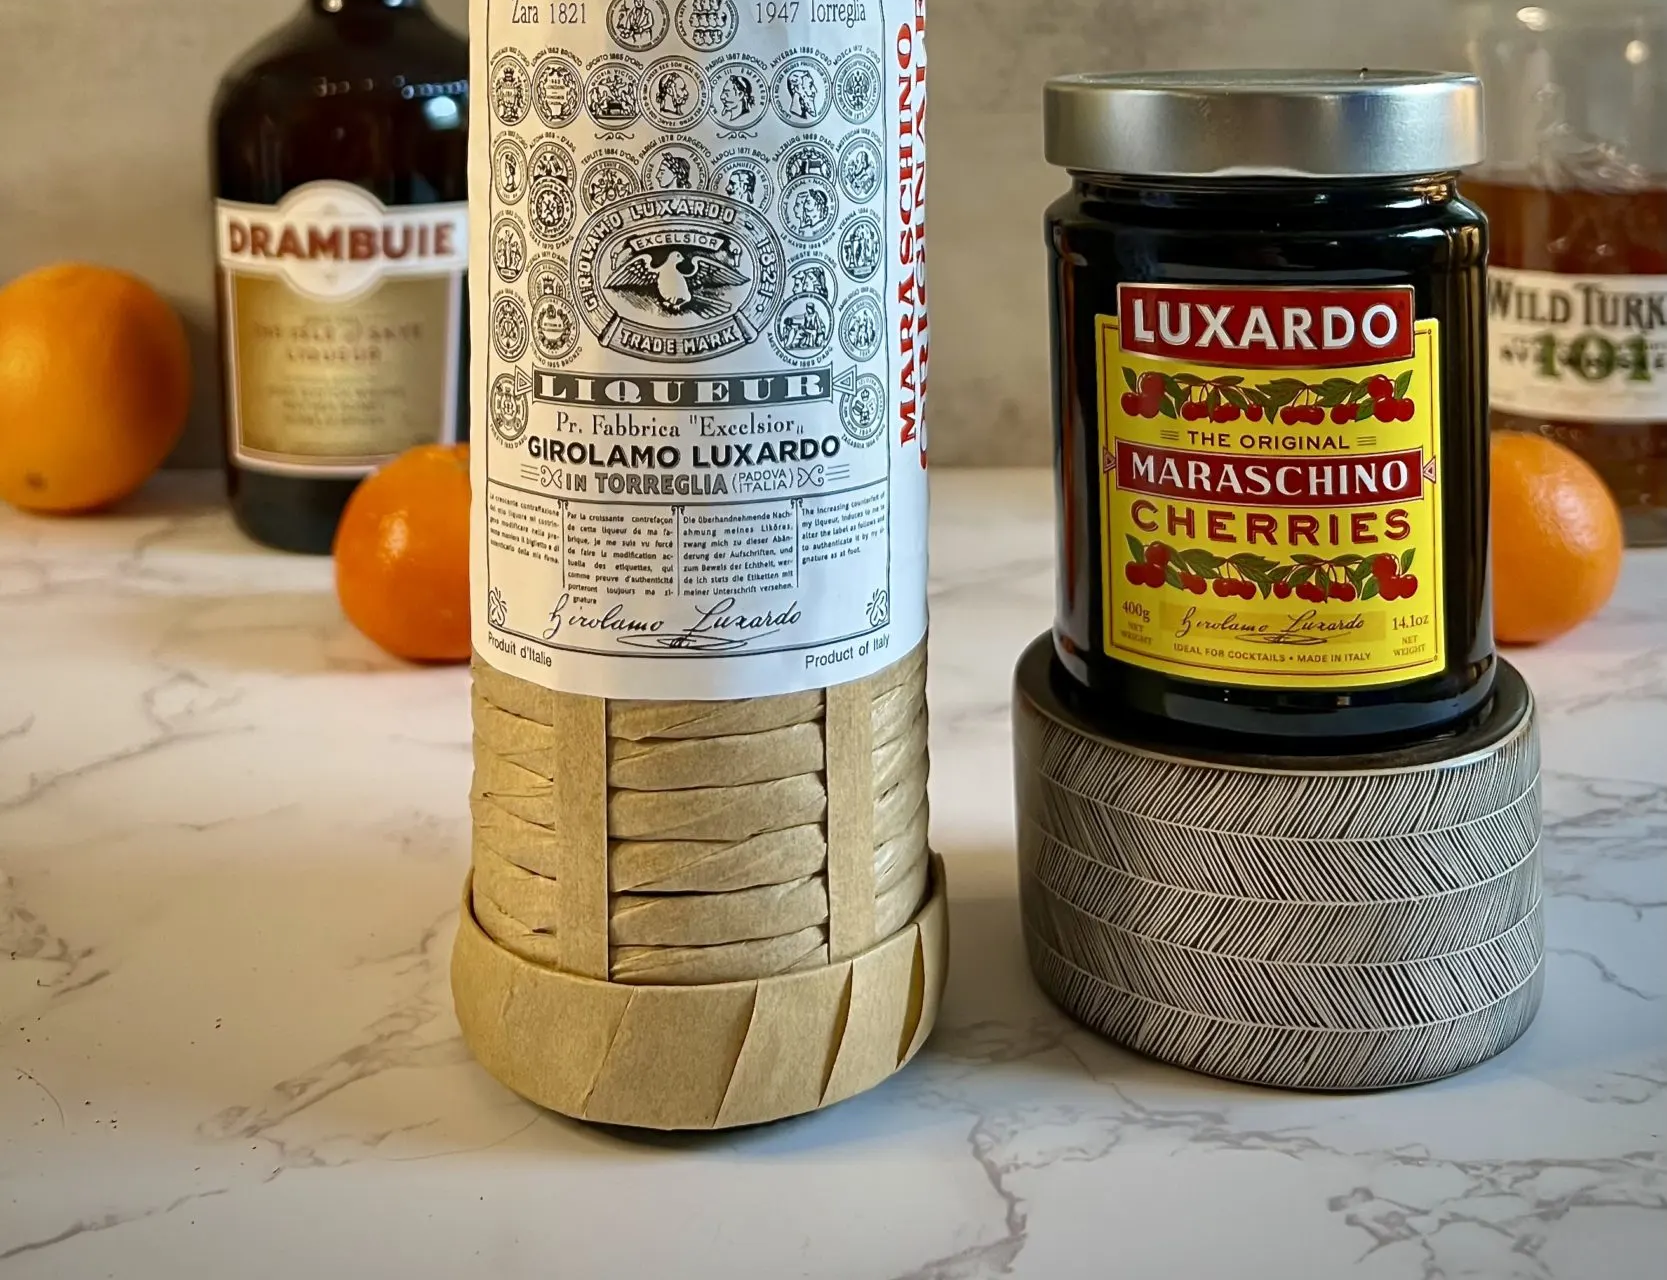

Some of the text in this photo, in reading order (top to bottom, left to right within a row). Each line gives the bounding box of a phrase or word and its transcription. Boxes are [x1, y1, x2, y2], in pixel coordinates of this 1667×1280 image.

[550, 3, 586, 24] 1821
[756, 2, 799, 23] 1947
[229, 222, 456, 260] DRAMBUIE
[636, 234, 718, 249] EXCELSIOR
[897, 23, 917, 449] MARASCHINO
[577, 199, 776, 312] GIROLAMO LUXARDO 1821
[1133, 297, 1398, 351] LUXARDO
[621, 326, 739, 356] TRADE MARK
[1533, 331, 1651, 381] 101
[539, 373, 824, 405] LIQUEUR
[556, 411, 582, 434] Pr.
[593, 414, 680, 437] Fabbrica
[528, 435, 841, 469] GIROLAMO LUXARDO
[1187, 431, 1350, 451] THE ORIGINAL
[566, 474, 587, 491] IN
[595, 471, 728, 496] TORREGLIA
[1131, 451, 1408, 496] MARASCHINO
[632, 516, 673, 525] contrefaçon
[802, 508, 814, 516] The
[1131, 500, 1411, 546] CHERRIES
[683, 529, 716, 537] ahmung
[684, 541, 706, 549] zwang
[746, 537, 768, 545] dieser
[683, 553, 709, 561] derung
[780, 546, 793, 554] und
[684, 588, 709, 596] meiner
[713, 586, 756, 595] Unterschrift
[683, 597, 802, 633] Luxardo
[1122, 601, 1150, 623] 400g
[1282, 610, 1364, 632] Luxardo
[1392, 614, 1429, 631] 14.1oz
[488, 632, 552, 667] Produit d'Italie
[1393, 644, 1426, 656] WEIGHT
[1402, 635, 1418, 645] NET
[806, 634, 890, 669] Product of Italy
[1174, 643, 1201, 655] IDEAL
[1205, 648, 1225, 657] FOR
[1227, 650, 1285, 662] COCKTAILS
[1331, 654, 1340, 662] IN
[1344, 652, 1370, 661] ITALY
